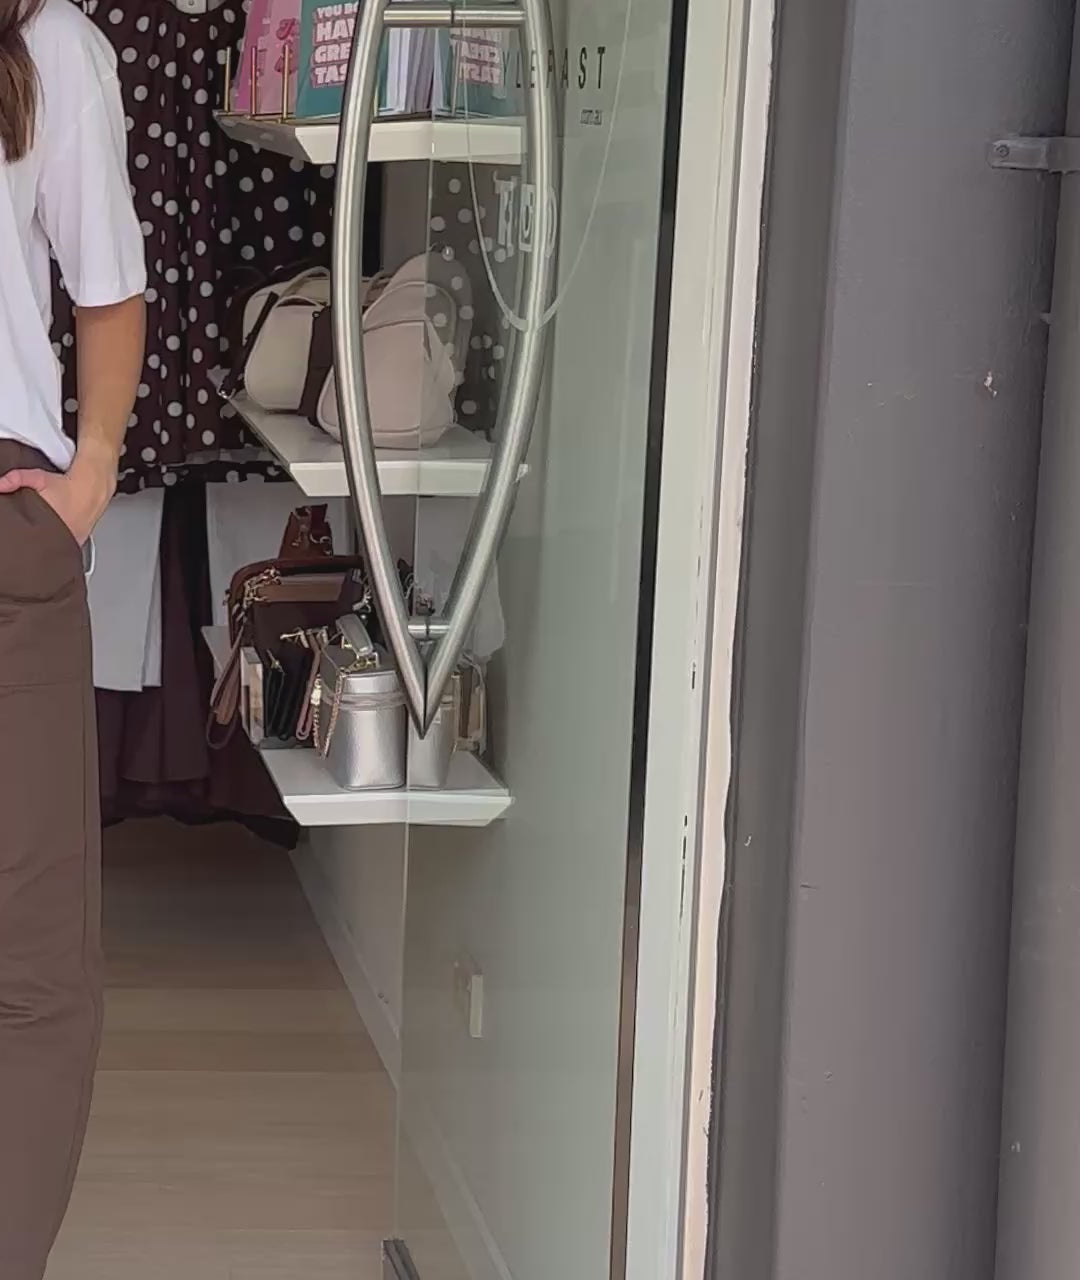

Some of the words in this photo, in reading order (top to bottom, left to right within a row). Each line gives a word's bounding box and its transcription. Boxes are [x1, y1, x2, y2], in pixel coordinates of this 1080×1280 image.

[316, 18, 355, 42] HAV
[315, 42, 352, 63] GRE
[315, 63, 348, 84] TAS
